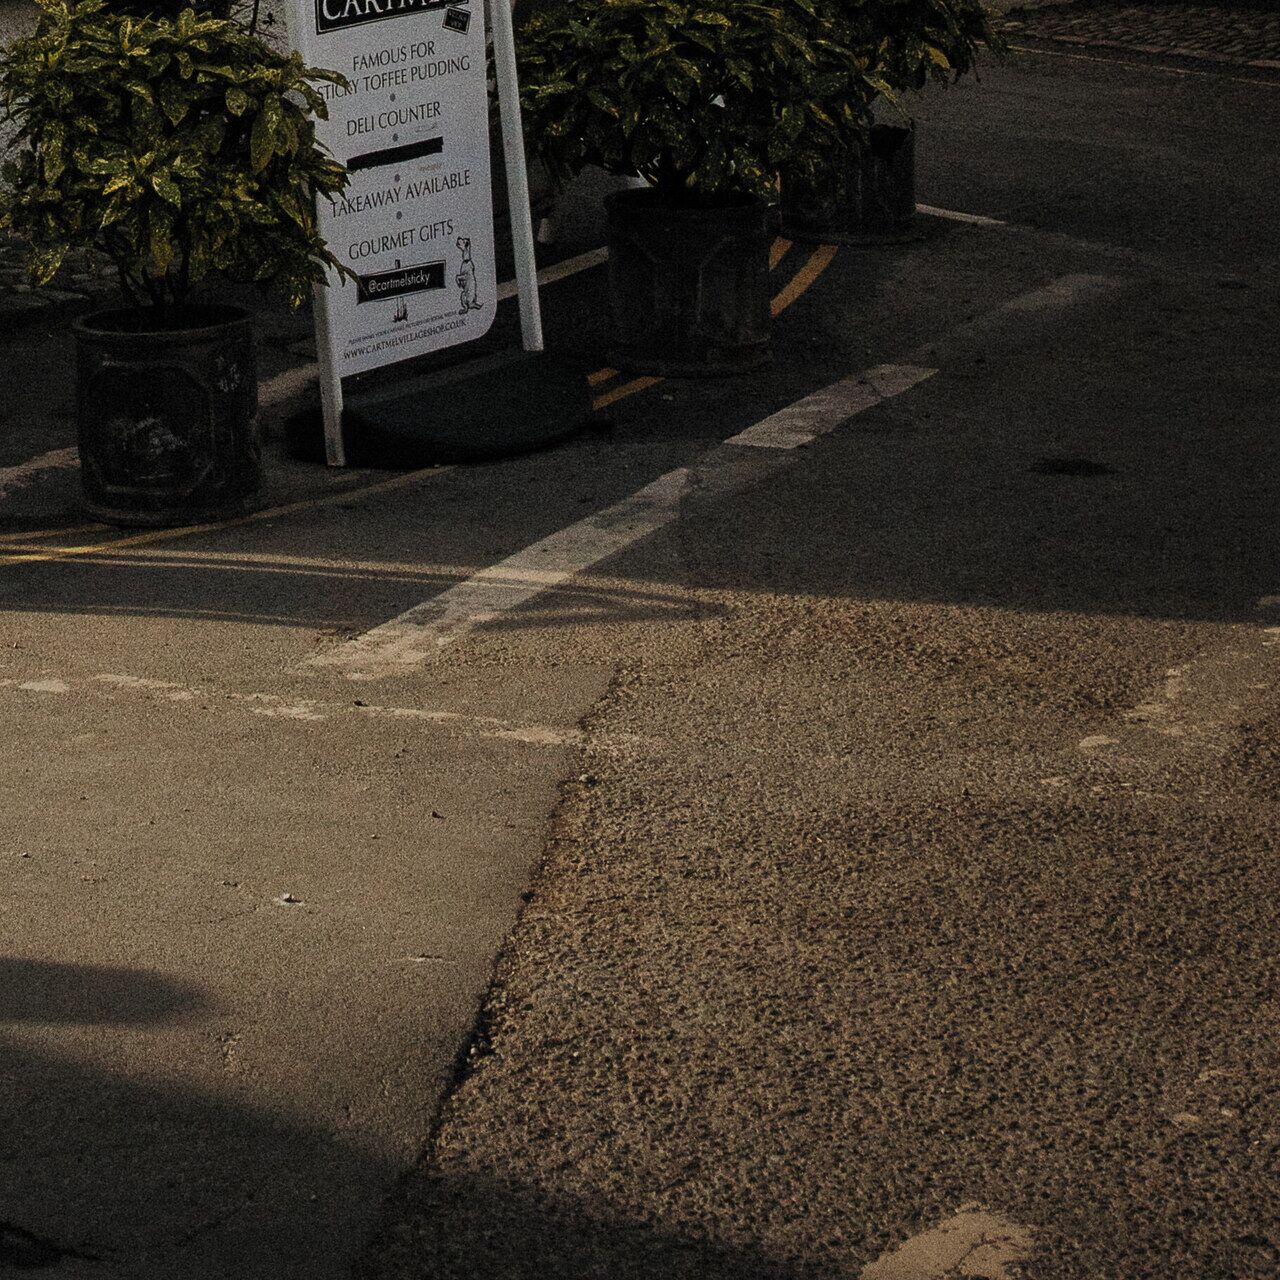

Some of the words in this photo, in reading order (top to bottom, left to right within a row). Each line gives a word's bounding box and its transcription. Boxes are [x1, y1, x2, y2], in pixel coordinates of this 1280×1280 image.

[353, 46, 407, 72] FAMOUS
[410, 40, 435, 59] FOR
[363, 68, 408, 92] TOFFEE
[411, 55, 470, 82] PUDDING
[347, 115, 374, 137] DELI
[378, 101, 441, 129] COUNTER
[330, 187, 402, 218] TAKEAWAY
[405, 169, 471, 200] AVAILABLE
[348, 228, 416, 260] GOURMET
[420, 219, 454, 242] GIFTS
[368, 270, 431, 293] @cartmelsticky
